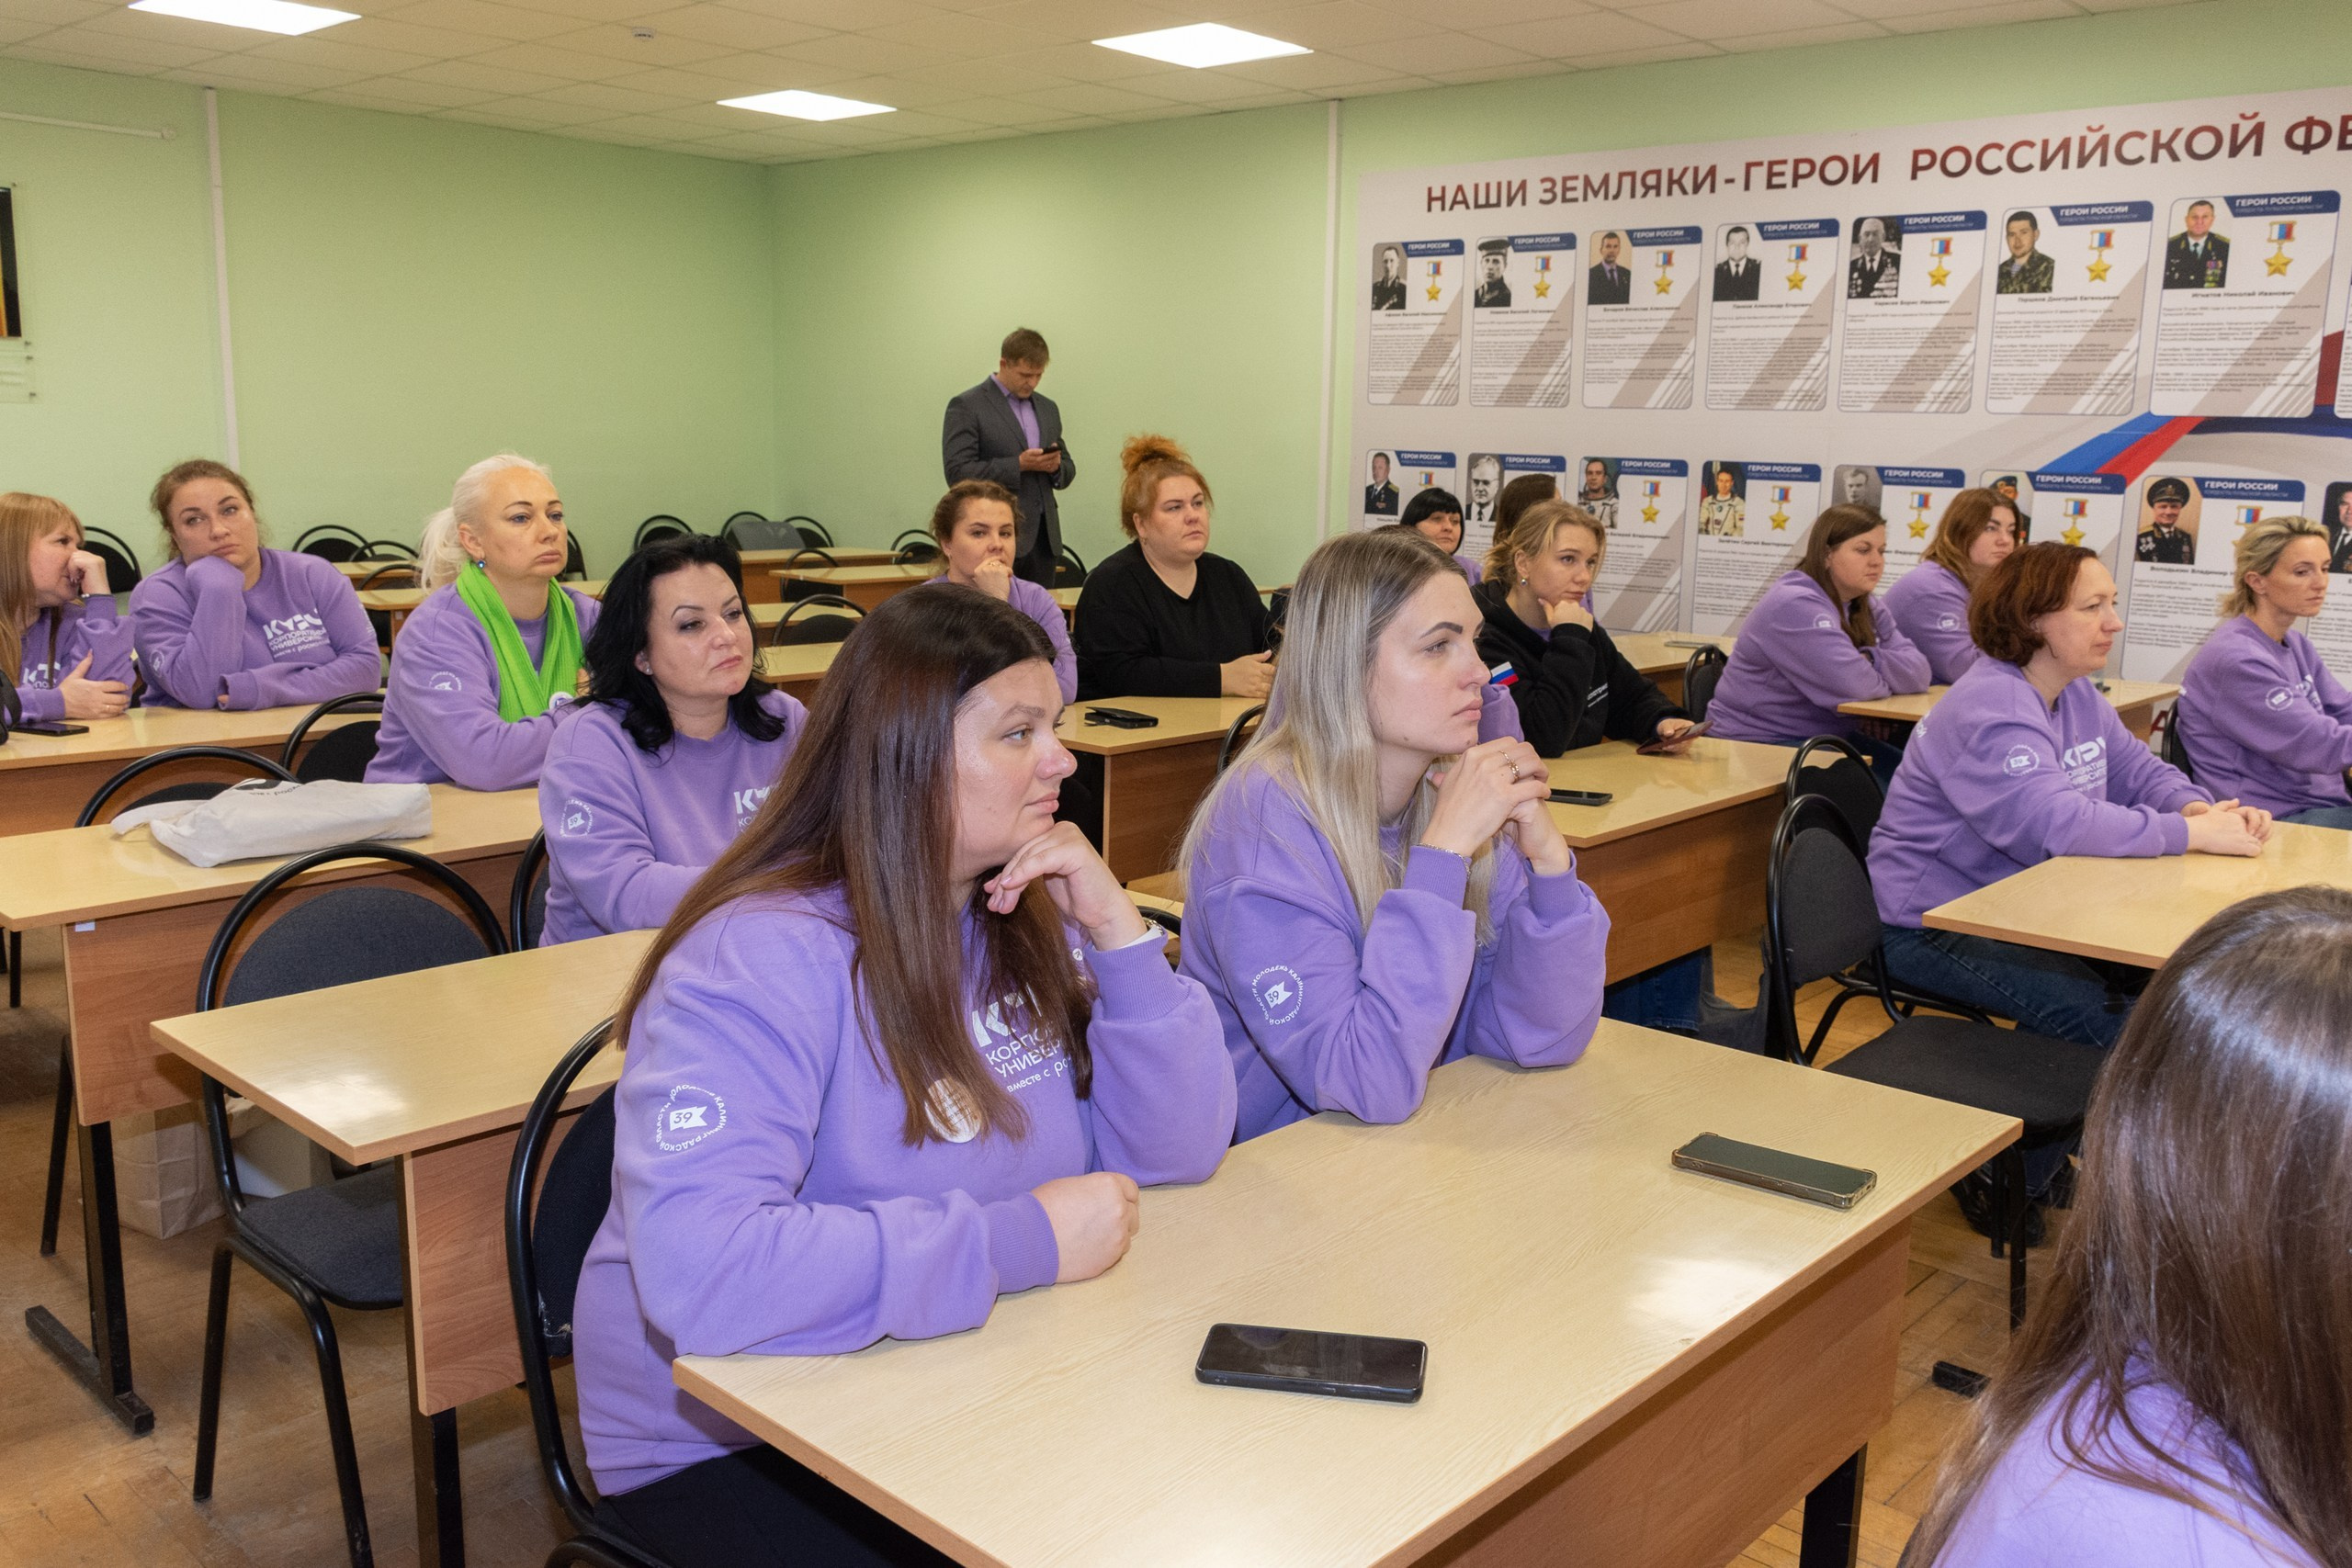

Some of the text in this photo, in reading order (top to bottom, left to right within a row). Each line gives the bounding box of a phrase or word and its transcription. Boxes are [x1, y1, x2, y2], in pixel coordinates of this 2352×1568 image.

[1427, 179, 1527, 212] НАШИ
[1910, 111, 2266, 180] РОССИЙСКОЙ
[2235, 196, 2312, 207] ГЕРОИ РОССИИ
[2205, 480, 2278, 491] ГЕРОИ РОССИИ
[1267, 990, 1280, 1003] 39
[995, 1038, 1064, 1077] УНИВЕР
[1007, 1070, 1042, 1093] вместе
[673, 1111, 693, 1124] 39
